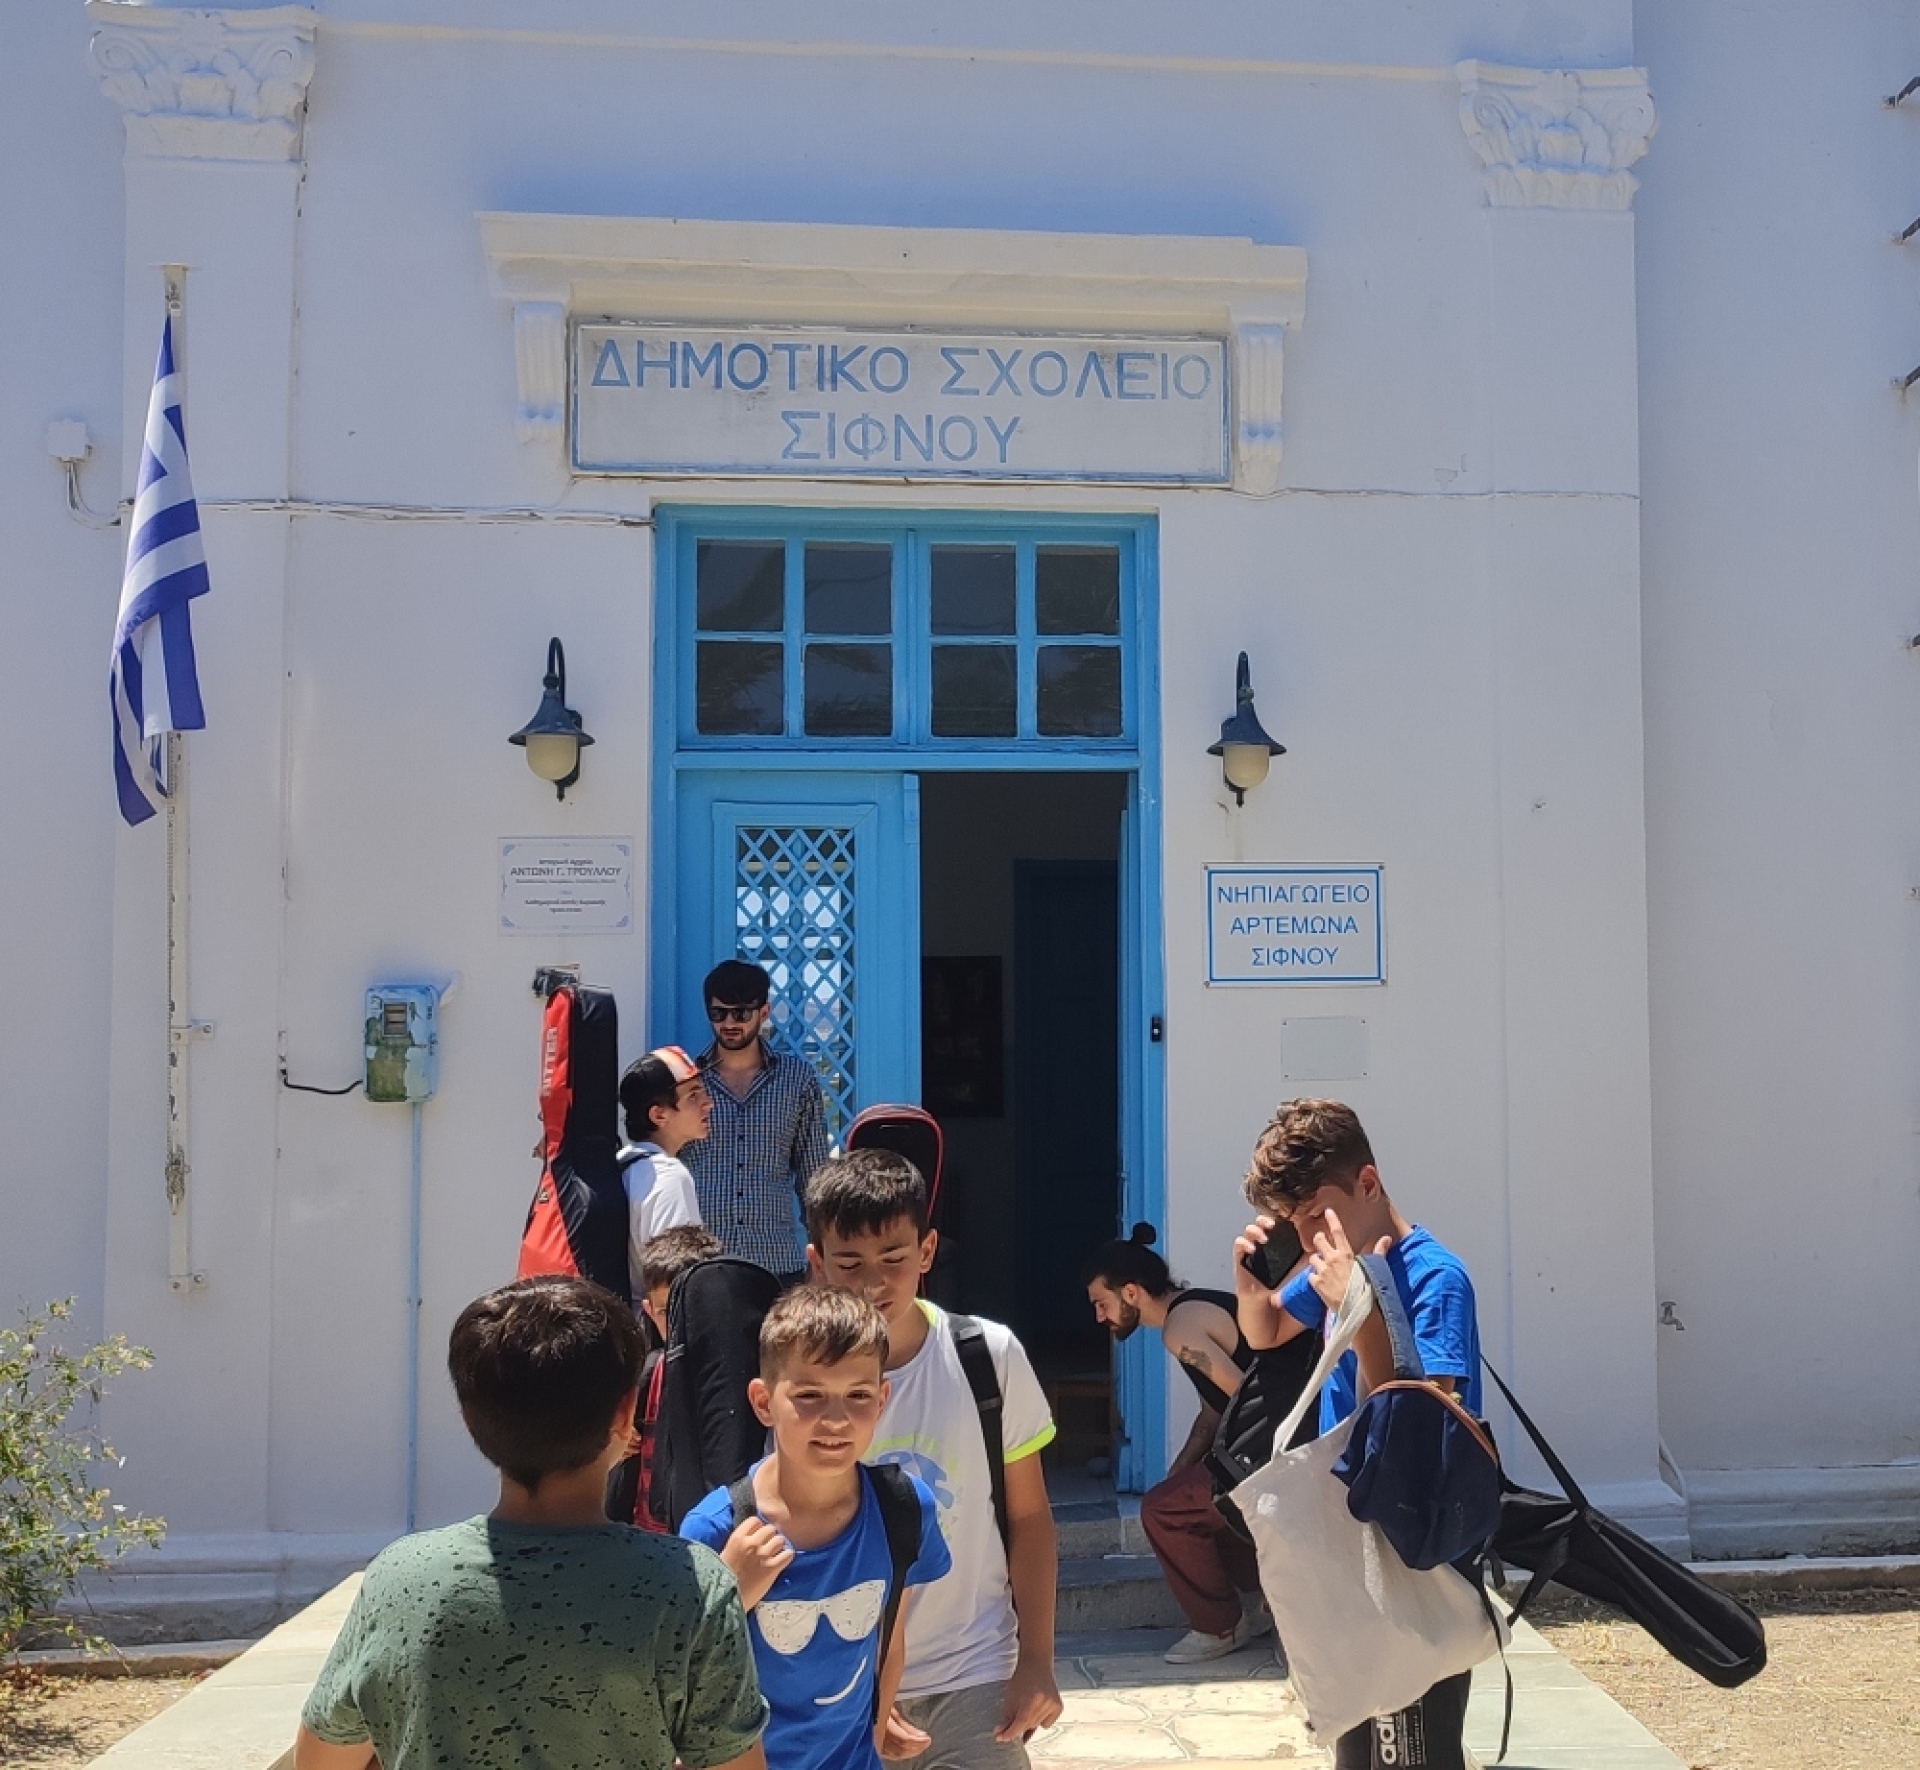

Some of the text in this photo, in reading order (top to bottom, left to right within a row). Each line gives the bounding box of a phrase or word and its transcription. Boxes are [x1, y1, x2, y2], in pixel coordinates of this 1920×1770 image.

[591, 339, 1211, 400] ΔΗΜΟΤΙΚΟ ΣΧΟΛΕΙΟ
[781, 410, 1021, 463] ΣΙΦΝΟΥ
[1217, 884, 1370, 903] ΝΗΠΙΑΓΩΓΕΙΟ
[1230, 915, 1359, 935] ΑΡΤΕΜΩΝΑ
[1251, 947, 1339, 966] ΣΙΦΝΟΥ
